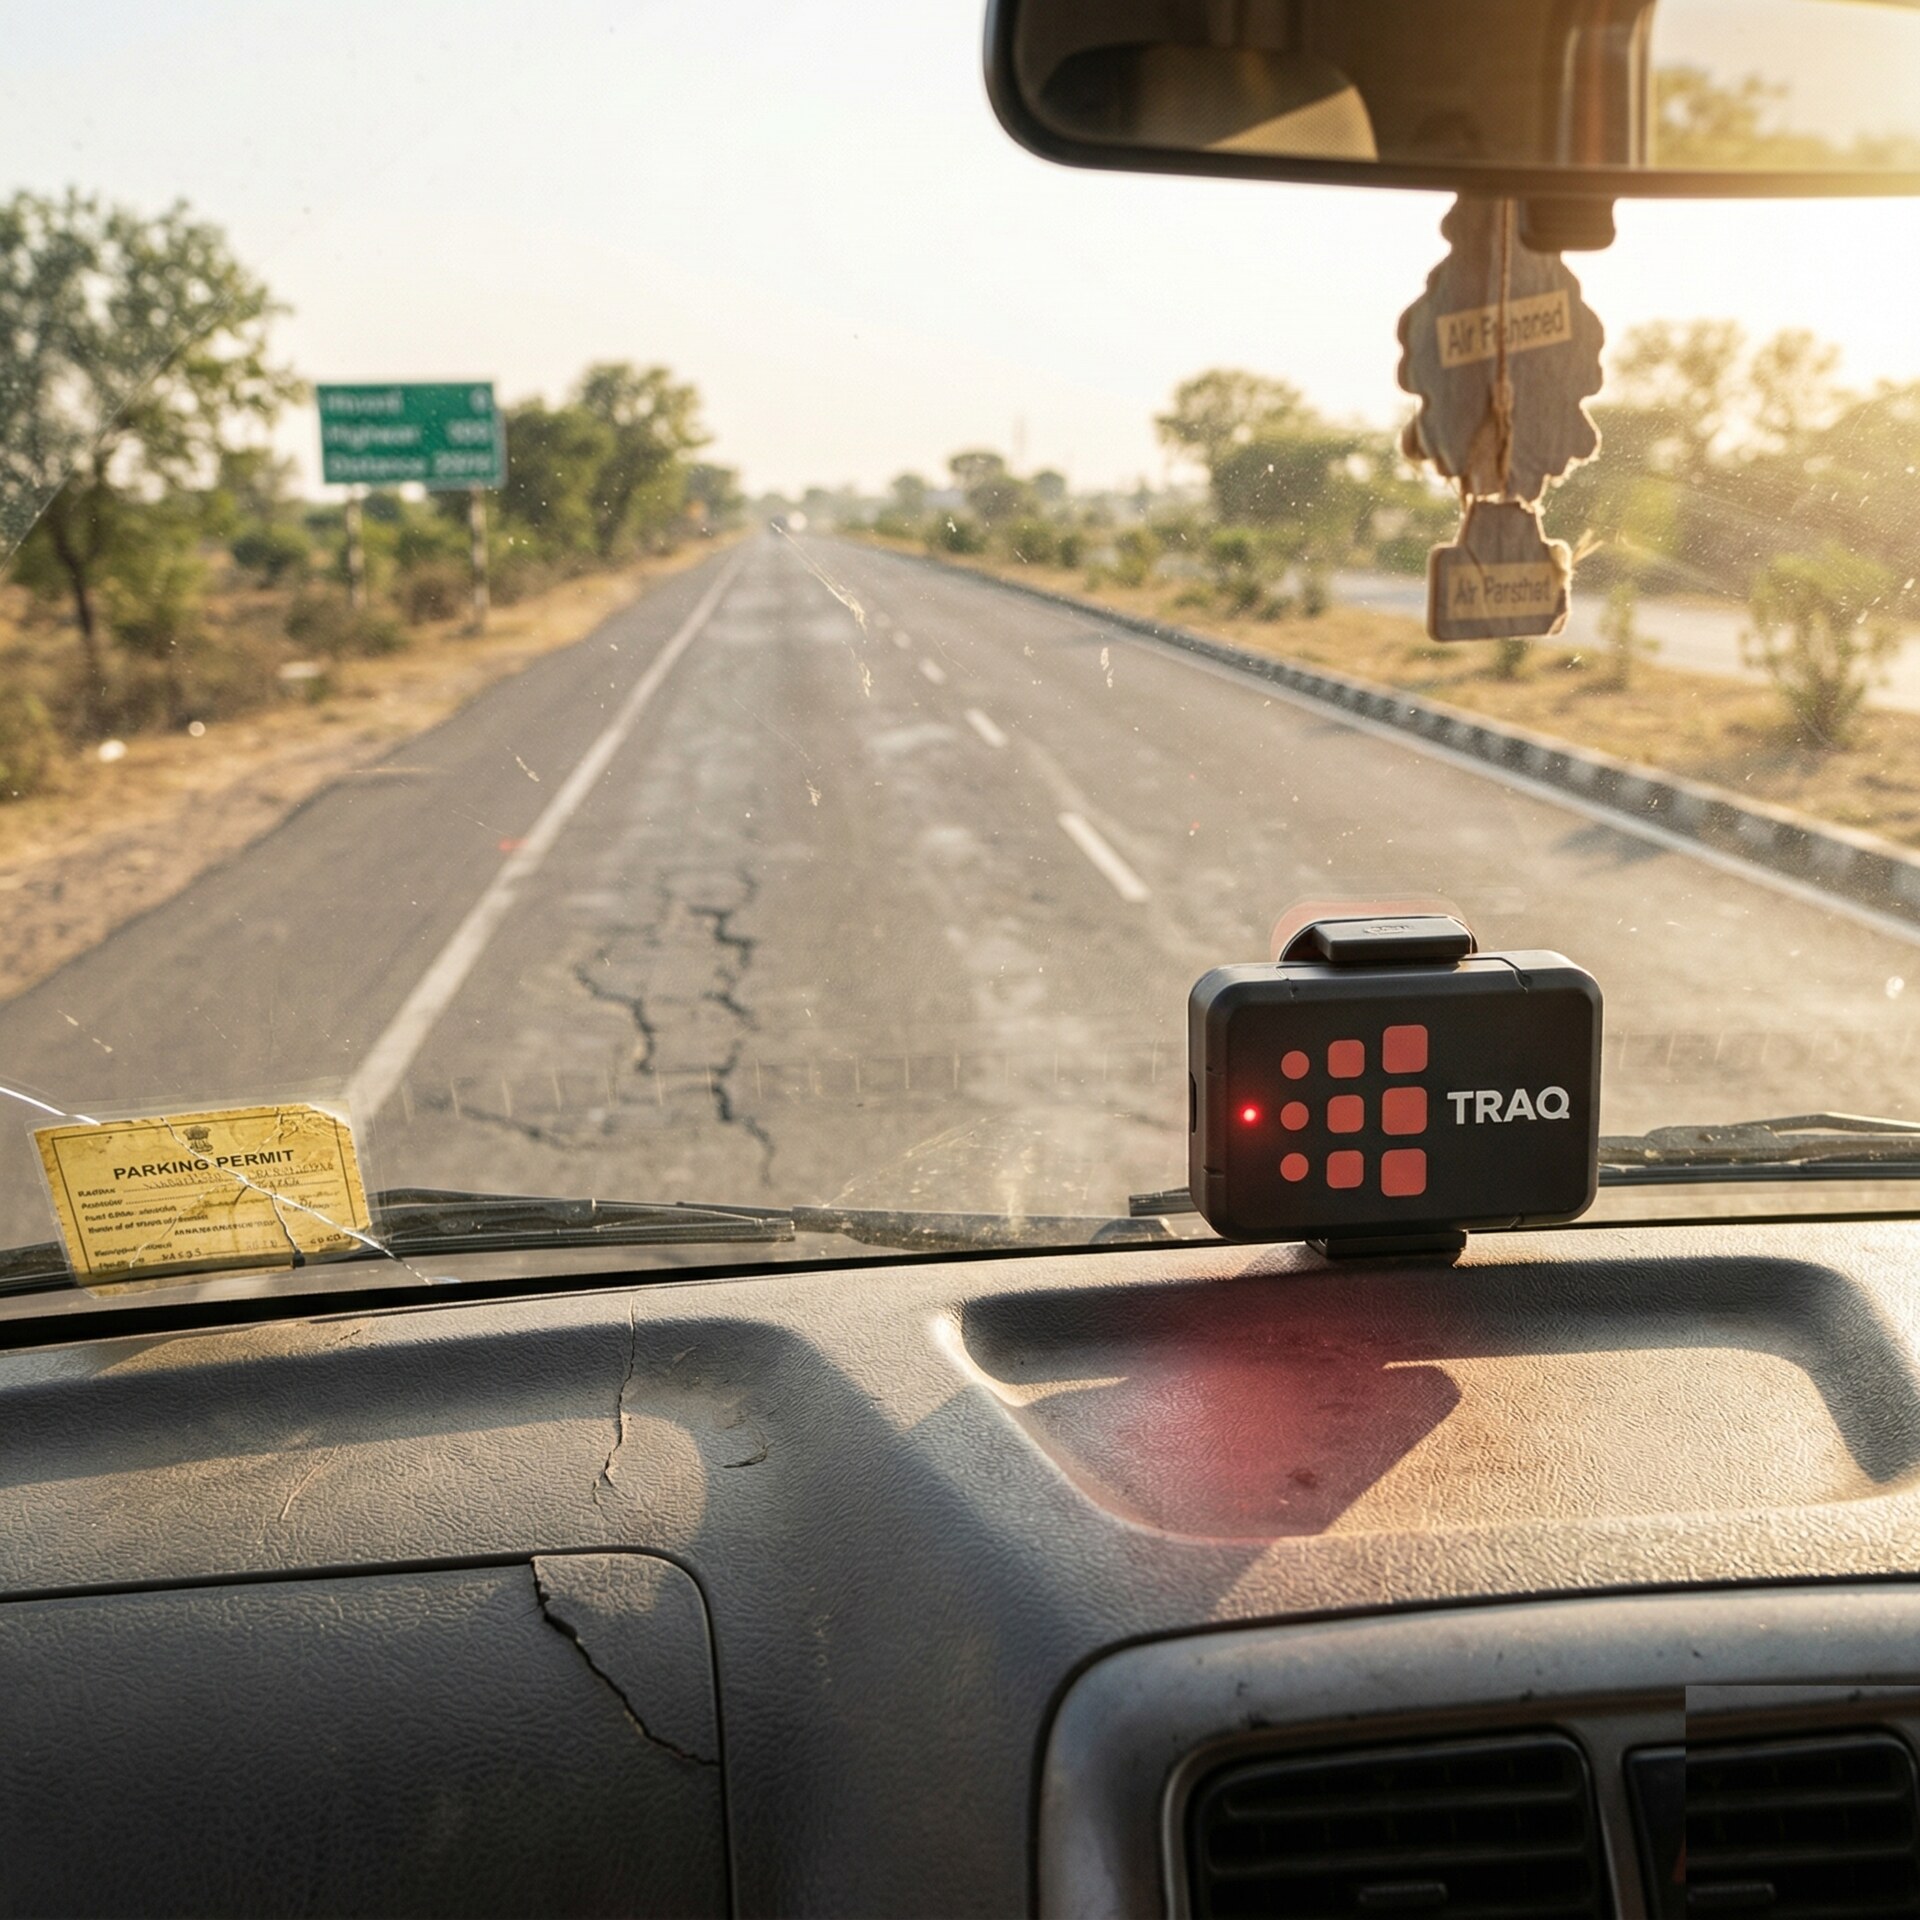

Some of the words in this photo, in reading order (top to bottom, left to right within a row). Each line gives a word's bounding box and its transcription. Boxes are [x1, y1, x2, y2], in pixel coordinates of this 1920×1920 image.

[1447, 1086, 1570, 1125] TRAQ
[113, 1158, 210, 1180] PARKING
[216, 1149, 294, 1169] PERMIT
